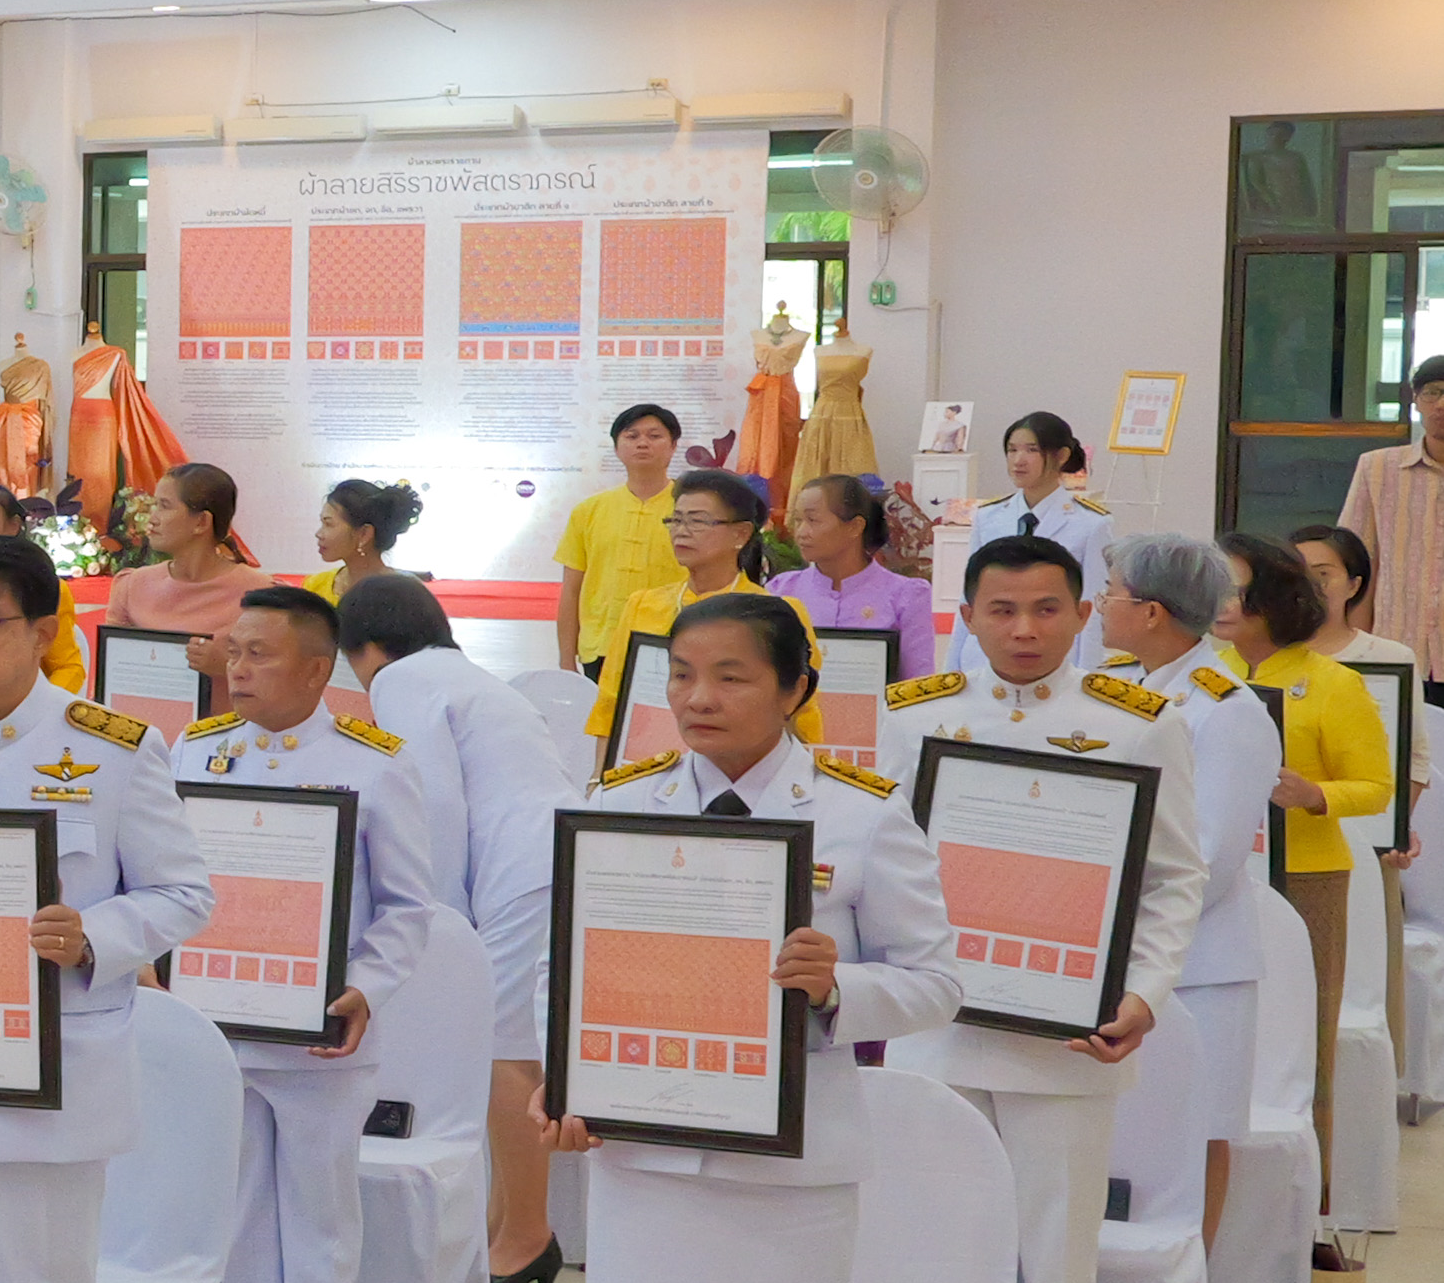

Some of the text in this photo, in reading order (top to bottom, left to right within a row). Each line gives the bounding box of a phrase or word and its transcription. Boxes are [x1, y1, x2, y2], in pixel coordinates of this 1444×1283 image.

[299, 164, 597, 196] ผ้าลายสิริราชพัสตราภรณ์
